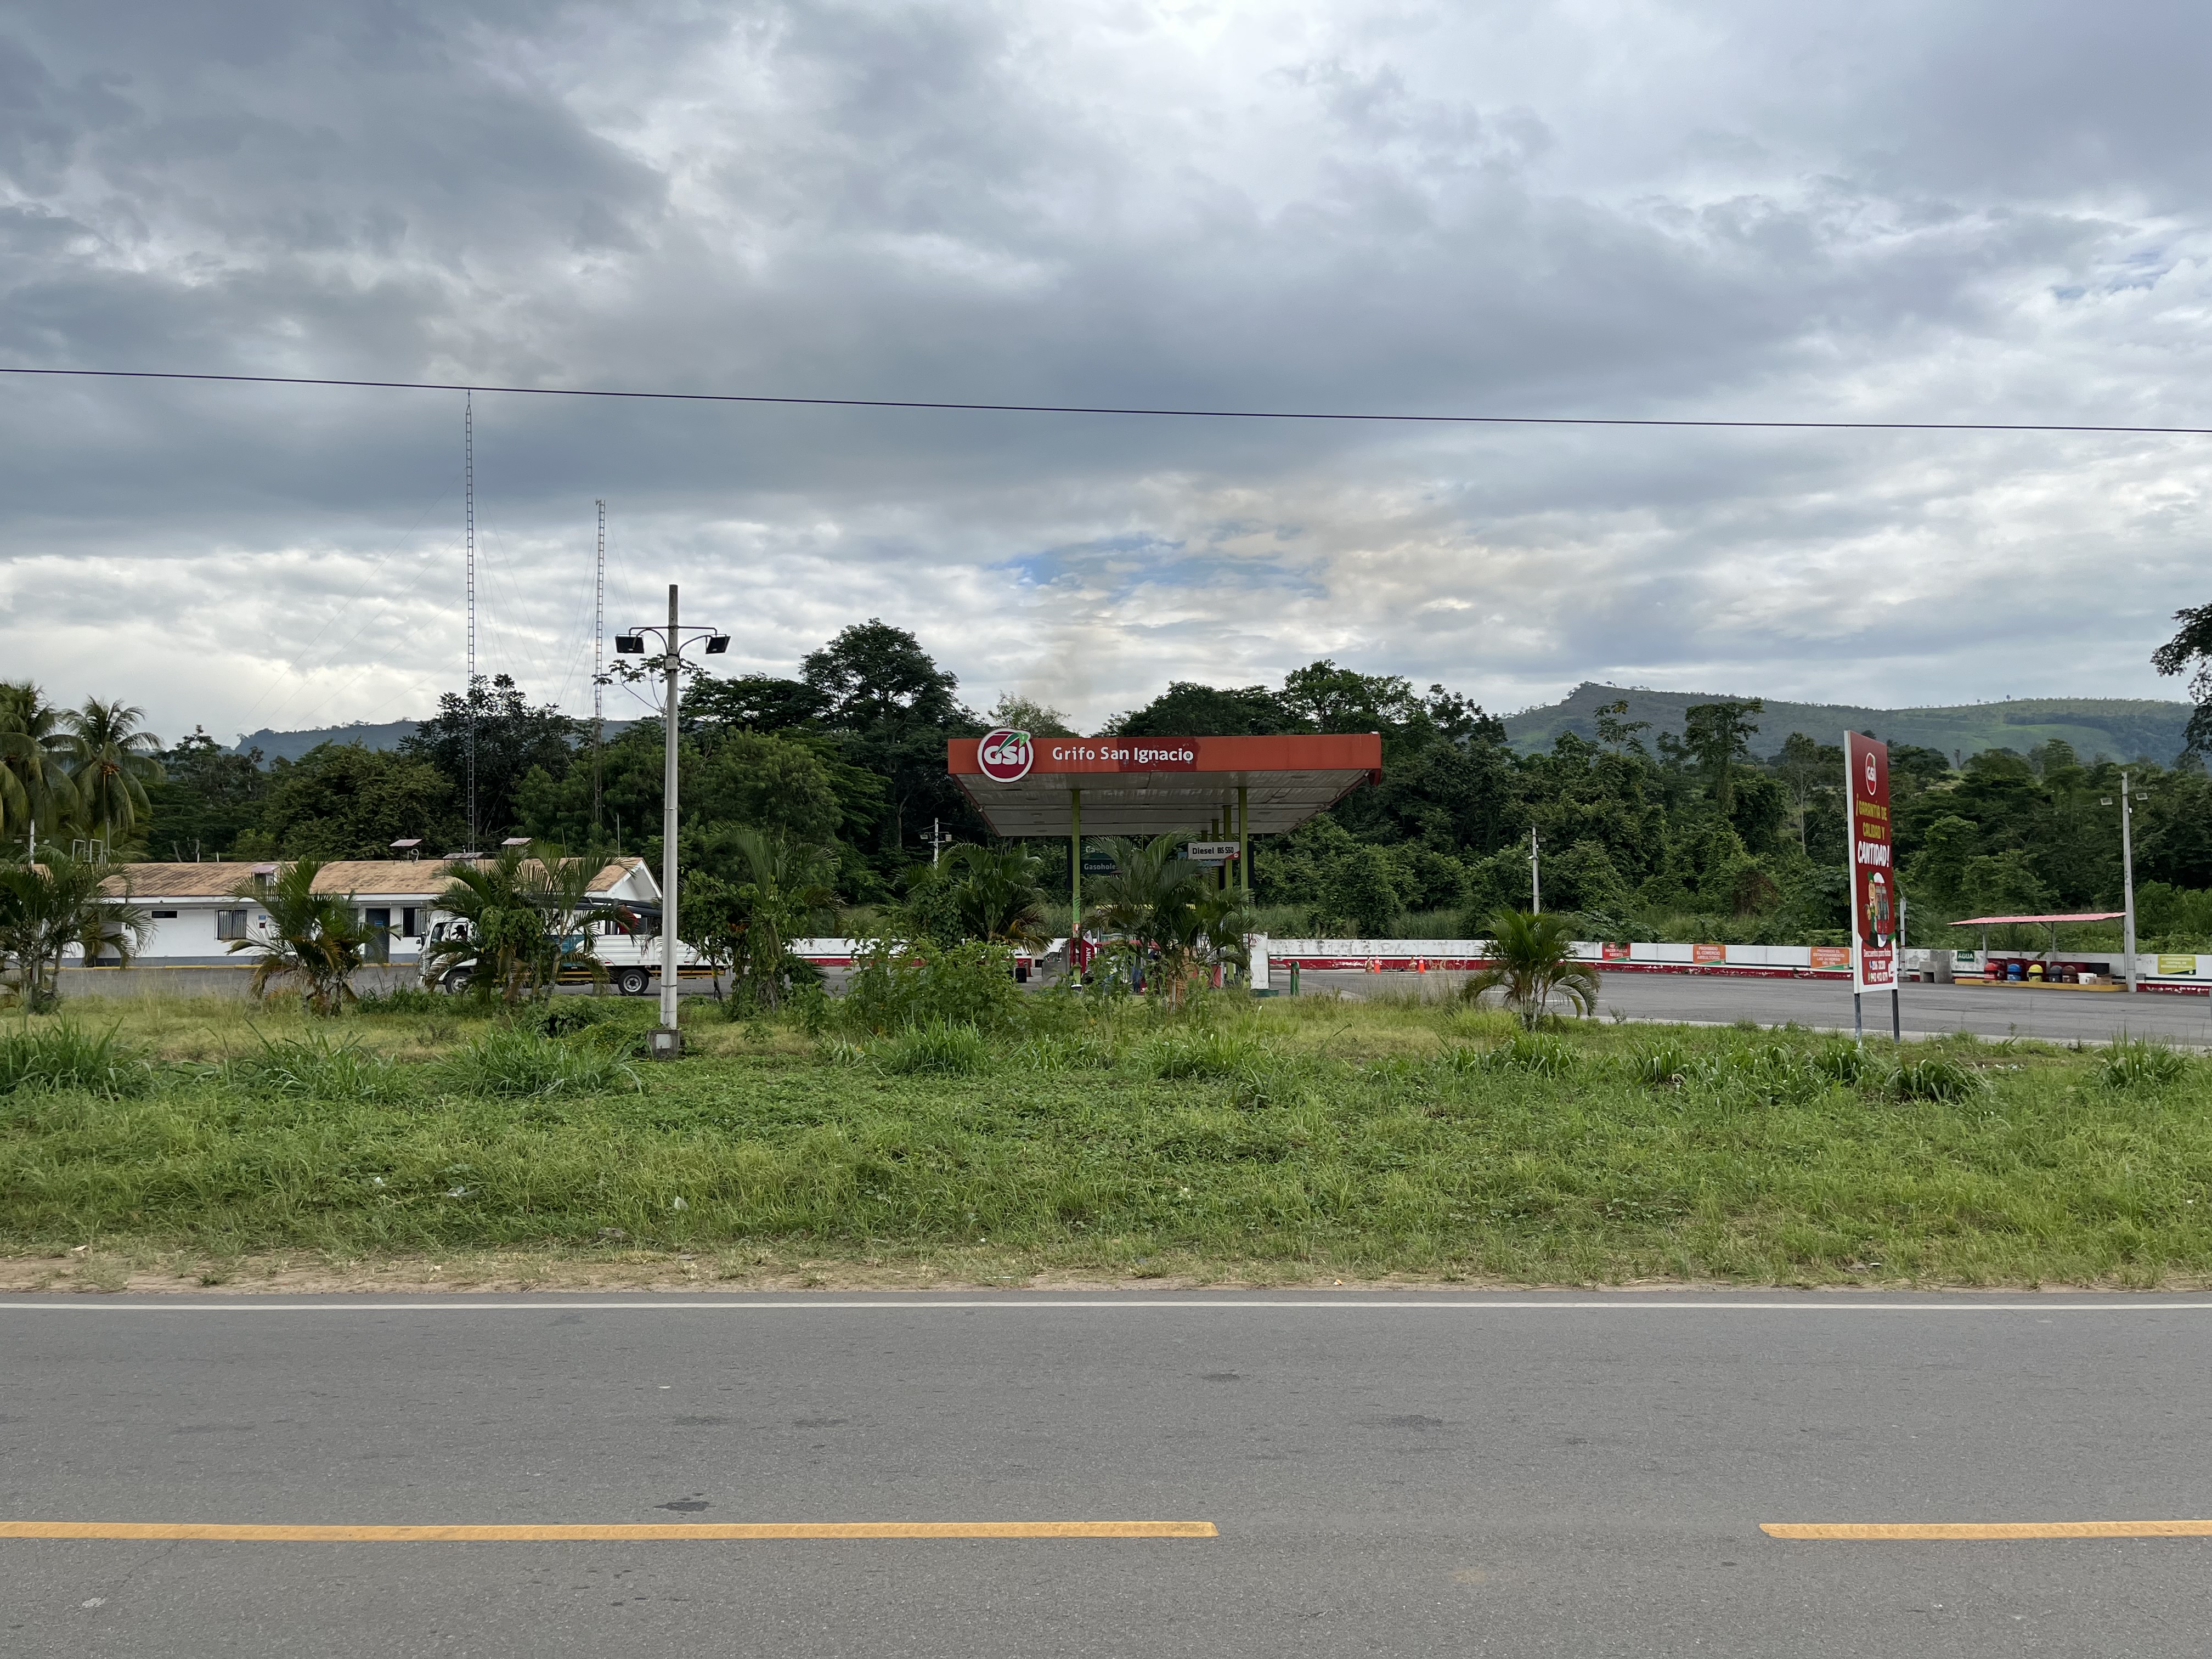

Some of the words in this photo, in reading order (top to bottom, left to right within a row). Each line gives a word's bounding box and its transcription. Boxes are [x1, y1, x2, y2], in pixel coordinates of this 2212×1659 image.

[984, 745, 1025, 765] GSI
[1052, 746, 1095, 760] Grifo
[1101, 746, 1129, 760] San
[1134, 747, 1194, 764] Ignacio
[1881, 826, 1885, 840] Y
[1192, 847, 1215, 855] Diesel
[1858, 840, 1890, 868] CANTIDAD!
